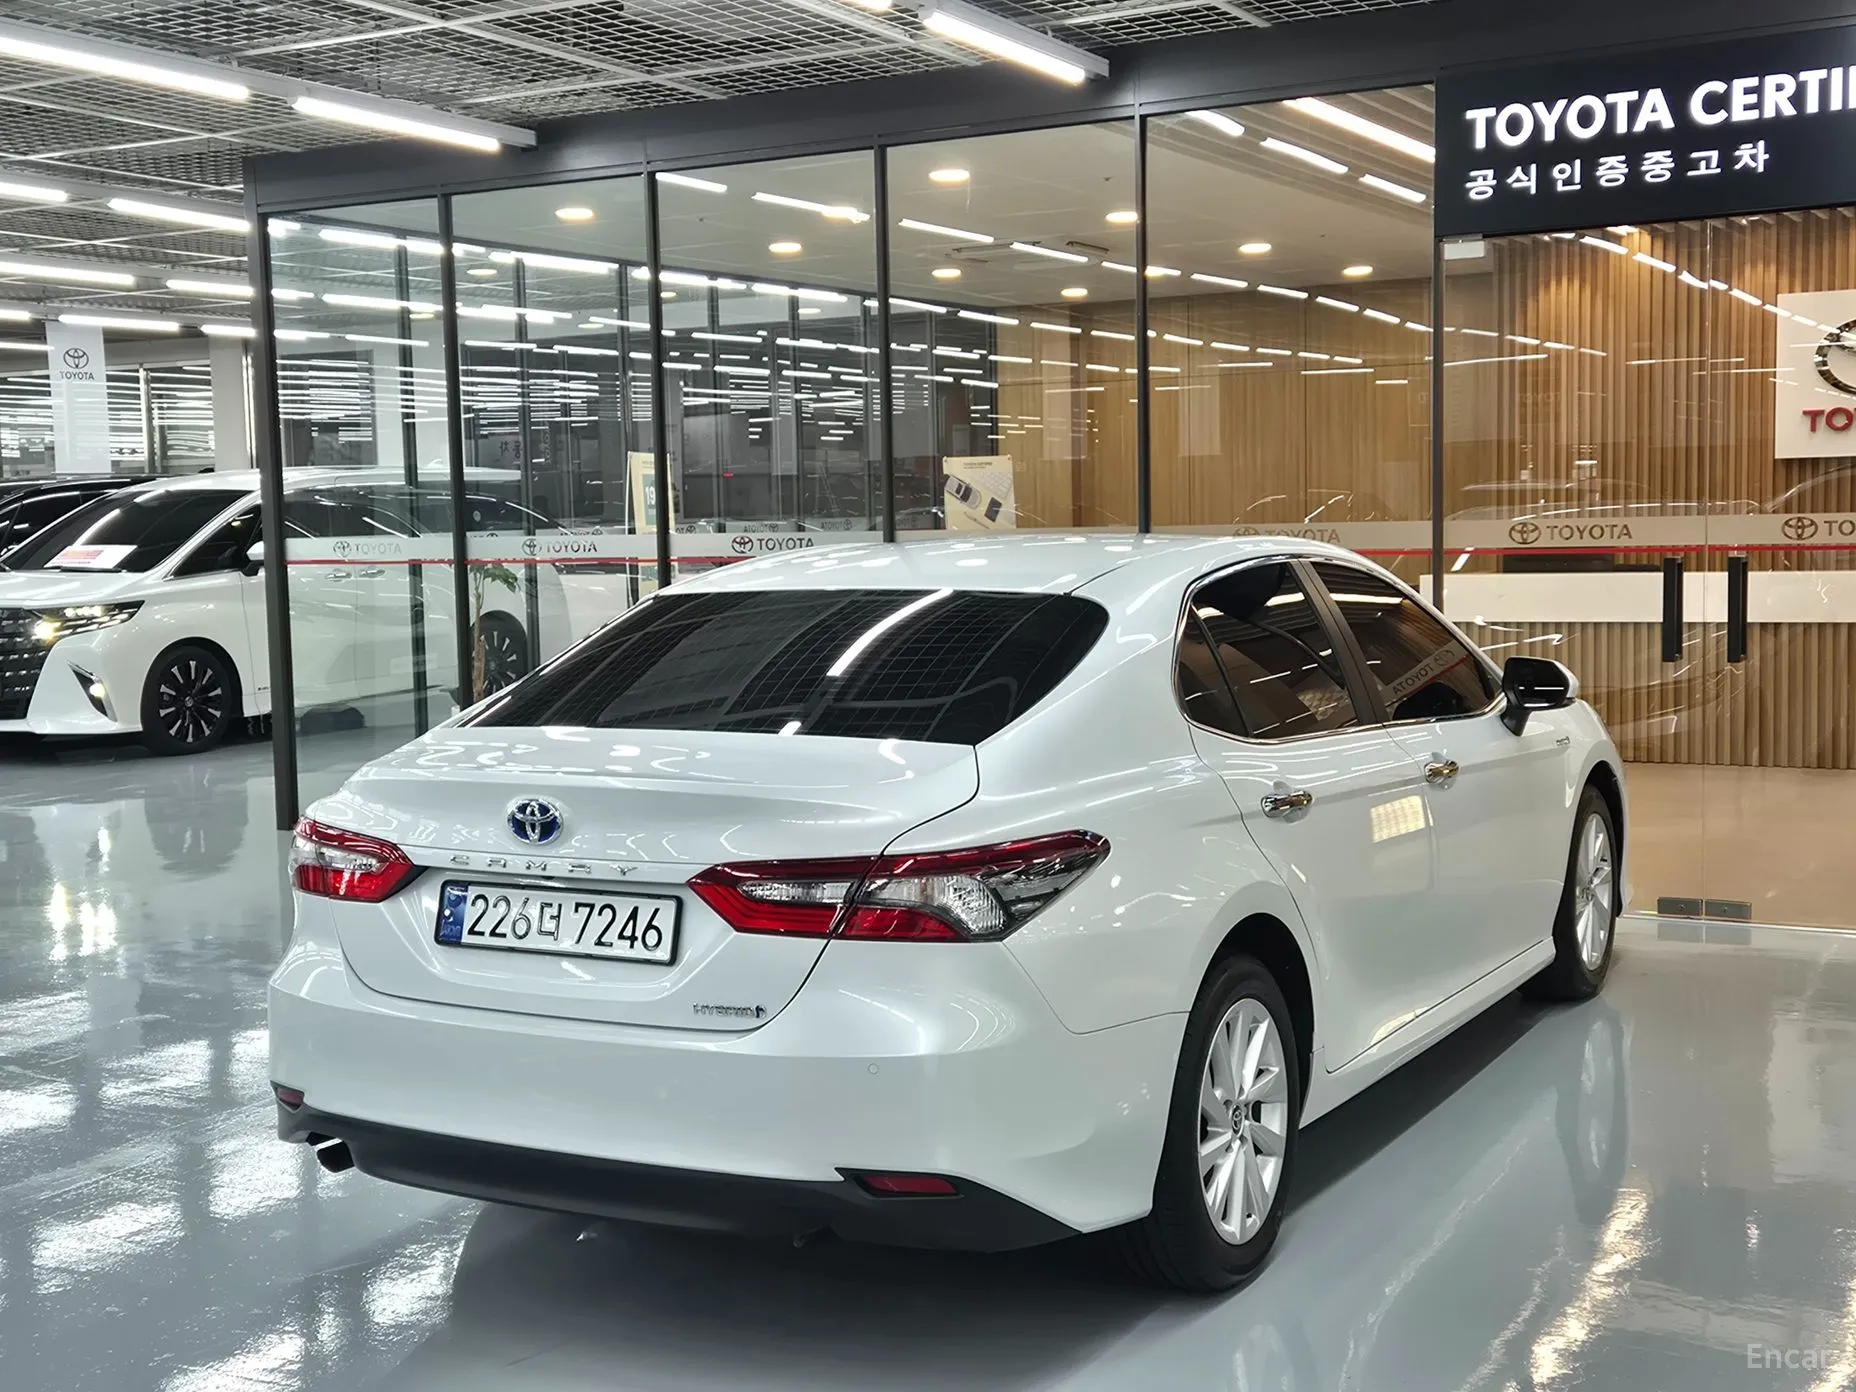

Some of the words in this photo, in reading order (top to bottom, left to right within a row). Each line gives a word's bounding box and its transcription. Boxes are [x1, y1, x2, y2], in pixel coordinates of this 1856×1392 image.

[1465, 88, 1675, 149] TOYOTA
[59, 371, 94, 380] TOYOTA
[1546, 524, 1633, 541] TOYOTA
[355, 543, 403, 555] TOYOTA
[545, 541, 598, 553] TOYOTA
[757, 538, 815, 551] TOYOTA
[450, 855, 638, 876] CAMRY
